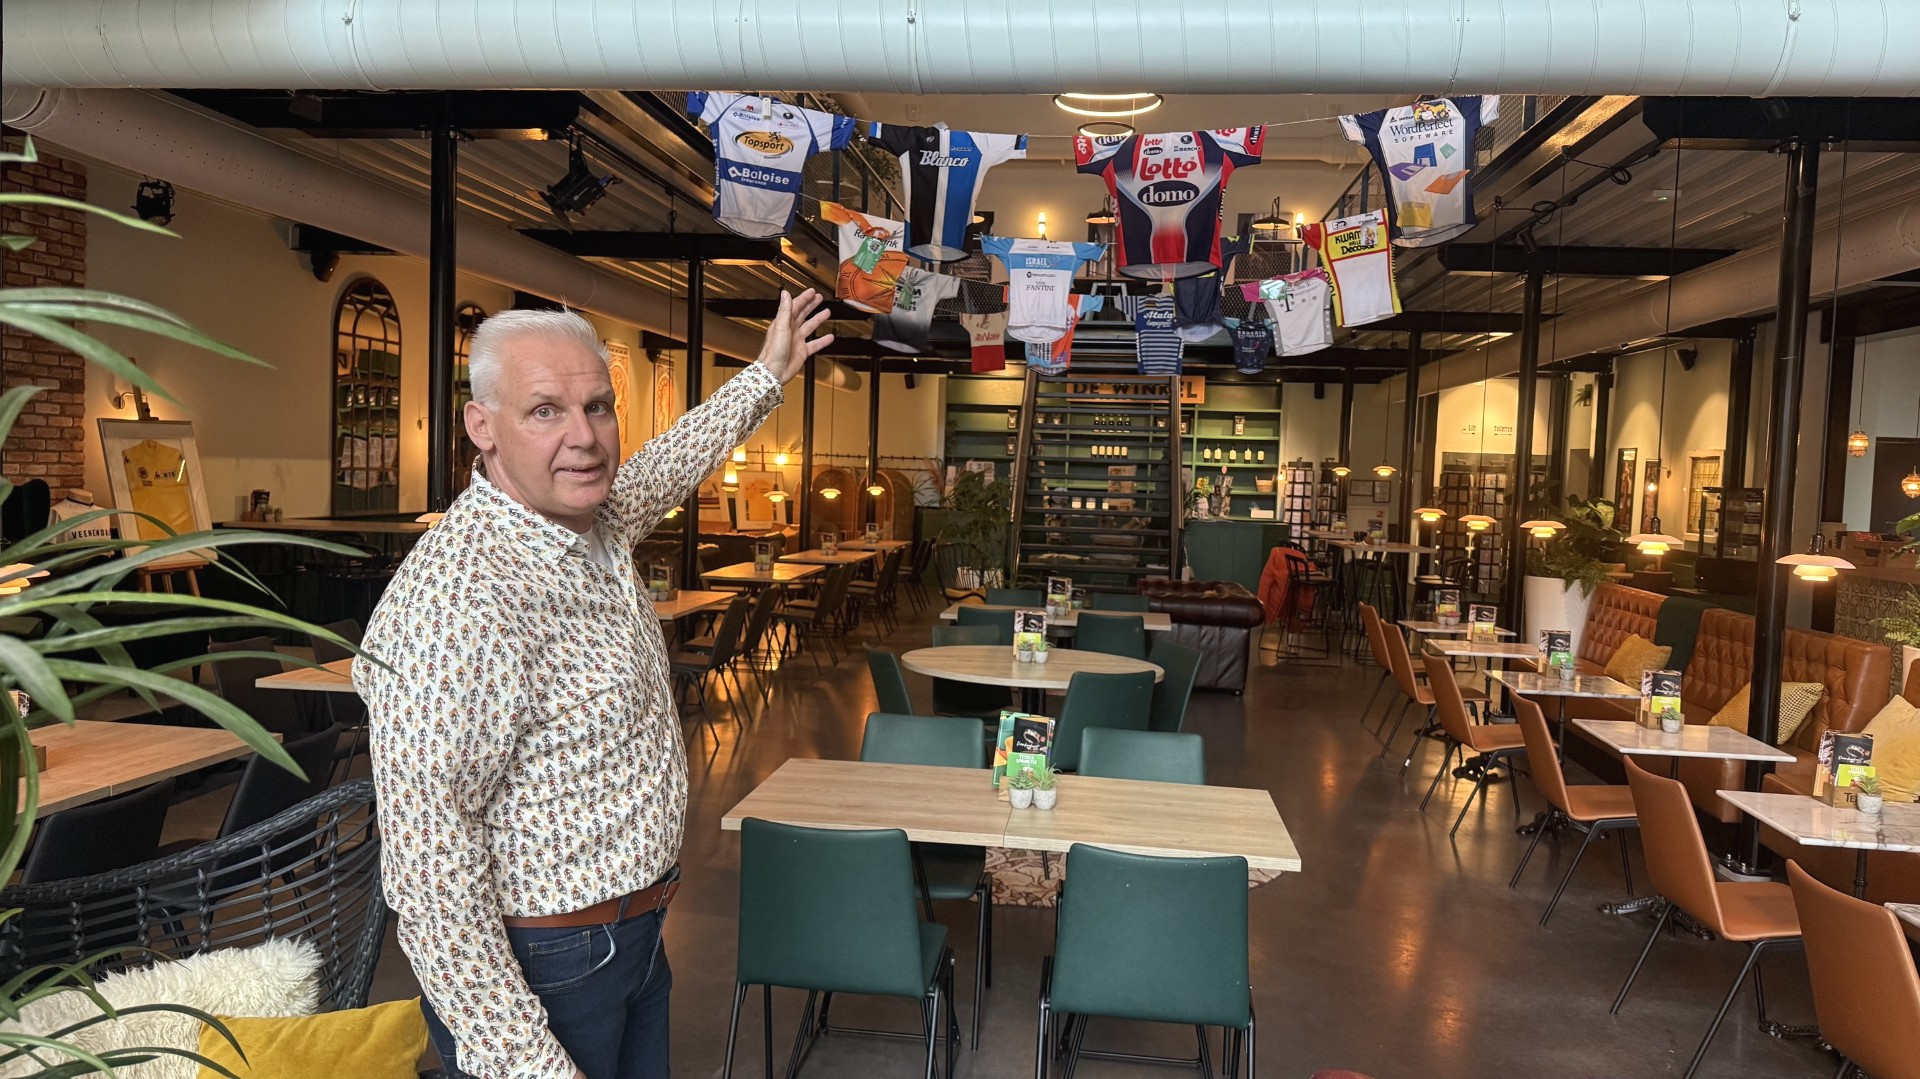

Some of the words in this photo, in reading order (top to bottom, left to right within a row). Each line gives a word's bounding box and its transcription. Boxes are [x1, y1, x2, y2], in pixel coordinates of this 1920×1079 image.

[1390, 118, 1453, 136] WordPerfect
[744, 135, 785, 150] Topsport
[1394, 129, 1453, 144] SOFTWARE
[919, 149, 969, 168] Blanco
[742, 167, 790, 185] Baloise
[1142, 188, 1196, 205] domo
[854, 229, 899, 249] Raank
[1335, 230, 1362, 245] KWAN
[1025, 257, 1047, 266] ISRAEL
[1026, 284, 1055, 292] FANTINI
[1143, 310, 1174, 322] Atala
[1073, 383, 1100, 395] DE
